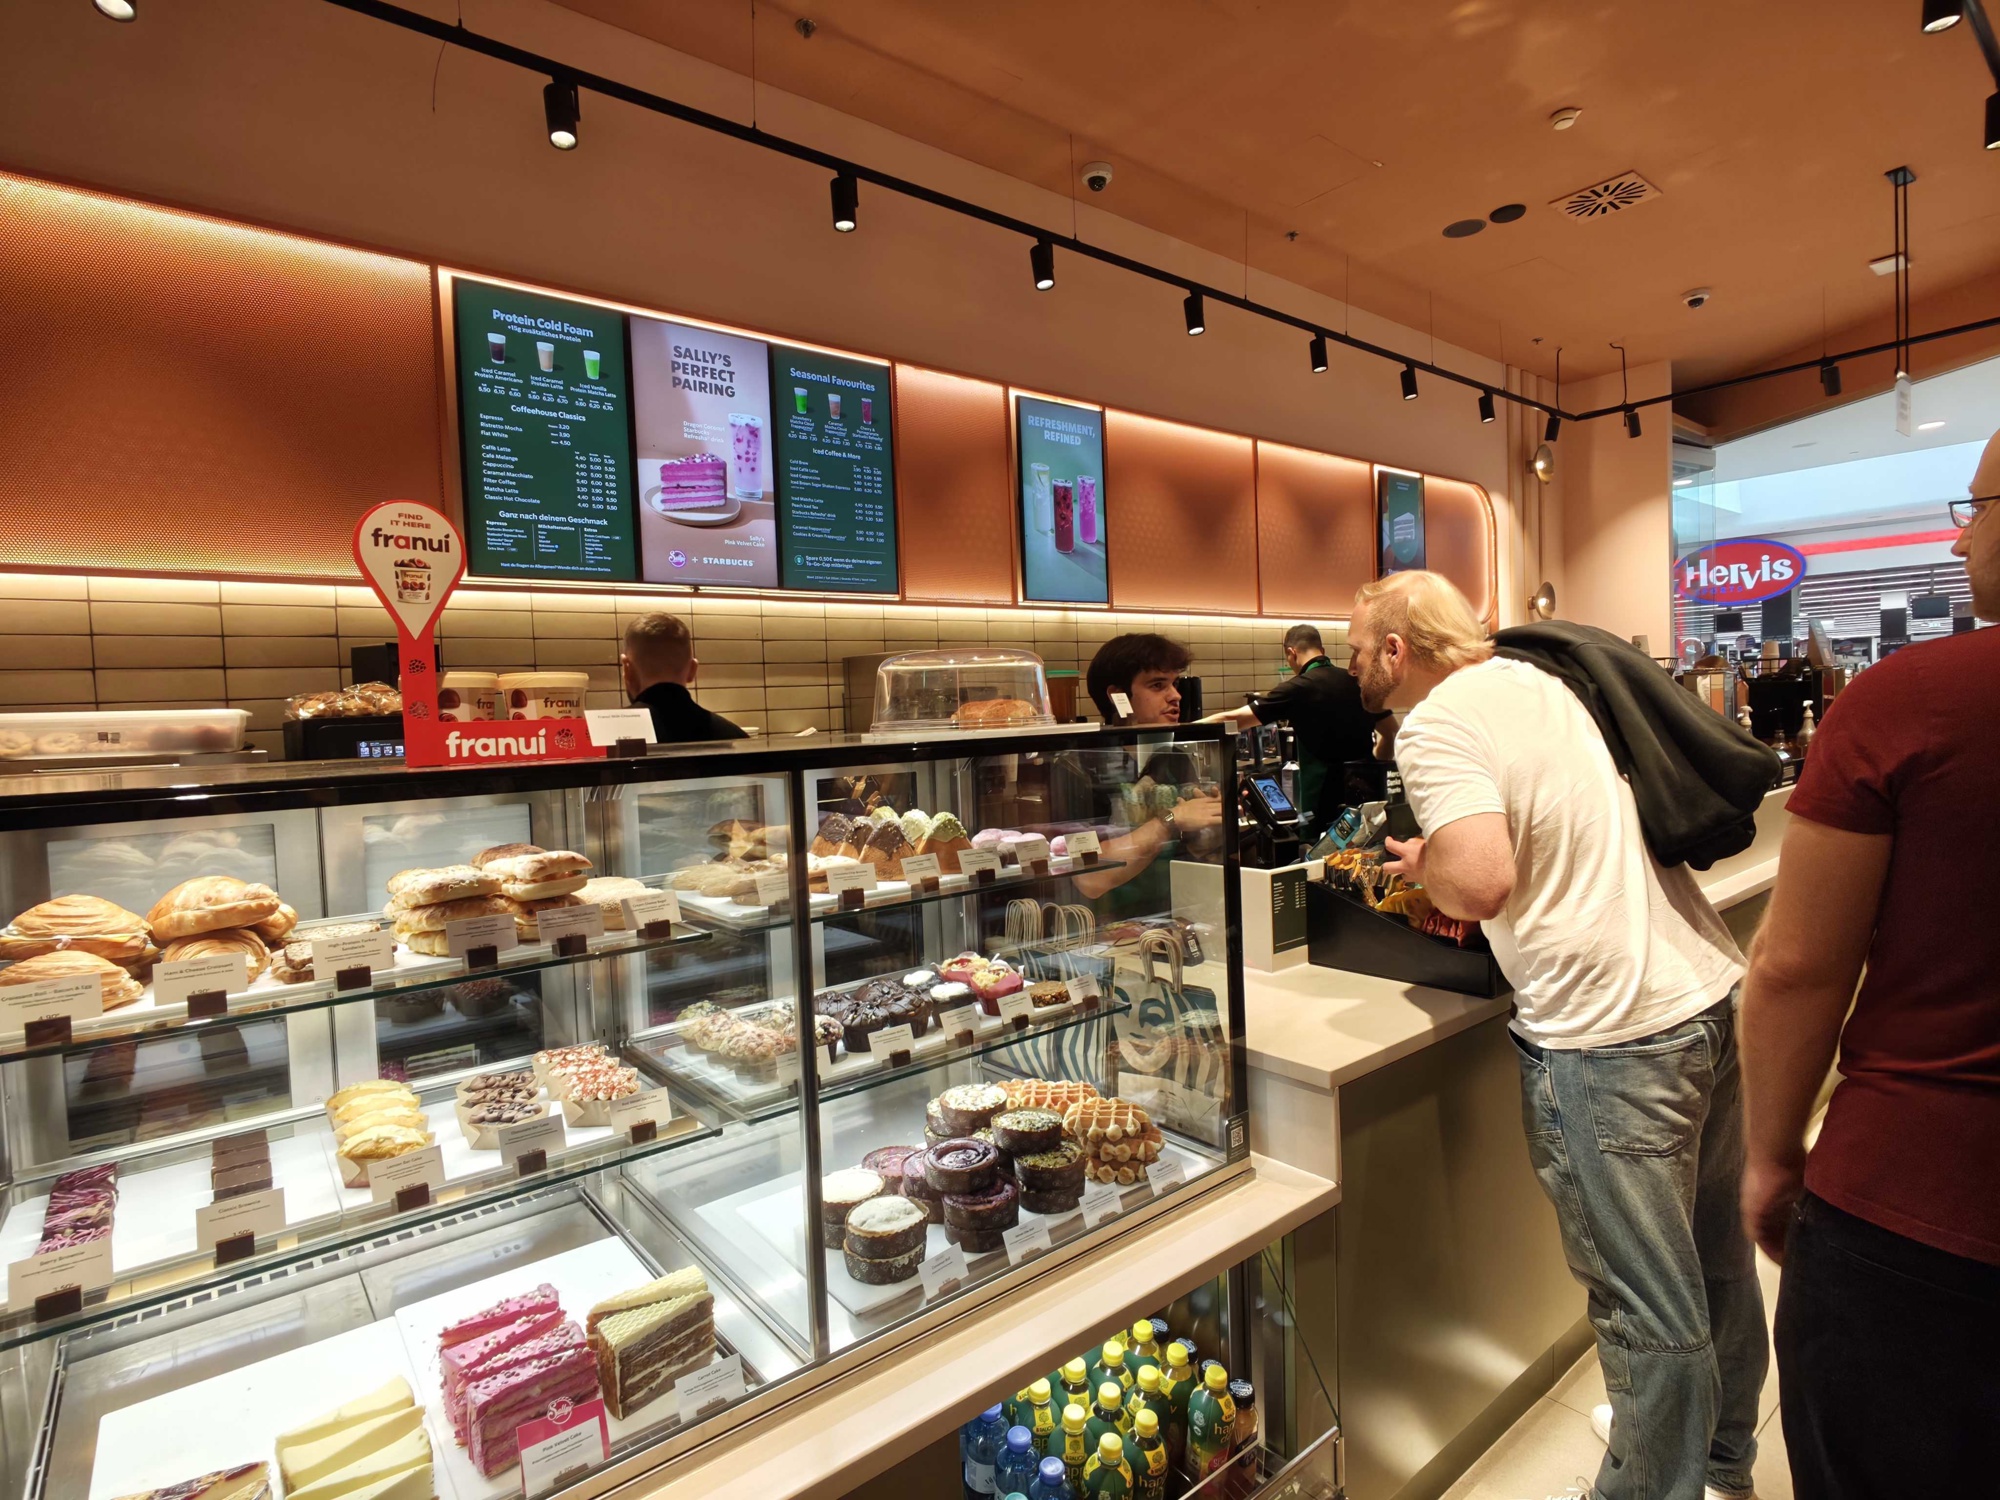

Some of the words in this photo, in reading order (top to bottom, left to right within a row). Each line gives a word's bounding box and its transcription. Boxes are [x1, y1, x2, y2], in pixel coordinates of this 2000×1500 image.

[492, 309, 535, 326] Protein
[537, 319, 562, 332] Cold
[563, 323, 594, 337] Foam
[522, 327, 559, 339] zusätzliches
[559, 334, 582, 343] Protein
[673, 345, 731, 367] SALLY'S
[494, 369, 516, 377] Caramel
[671, 360, 735, 383] PERFECT
[495, 375, 523, 384] Americano
[531, 380, 550, 388] Protein
[542, 377, 564, 385] Caramel
[790, 368, 830, 384] Seasonal
[832, 376, 875, 392] Favourites
[672, 376, 735, 398] PAIRING
[511, 405, 557, 418] Coffeehouse
[558, 412, 586, 422] Classics
[480, 422, 504, 430] Ristretto
[683, 427, 710, 435] Starbucks
[1027, 415, 1096, 438] REFRESHMENT,
[1044, 430, 1082, 446] REFINED
[496, 454, 518, 462] Melange
[482, 461, 514, 469] Cappuccino
[499, 511, 519, 519] Ganz
[520, 512, 537, 520] nach
[539, 514, 566, 522] deinem
[568, 516, 608, 525] Geschmack
[403, 521, 431, 529] HERE
[1686, 554, 1794, 589] Hervis
[1387, 770, 1400, 778] Merc
[554, 1438, 569, 1447] Velvet
